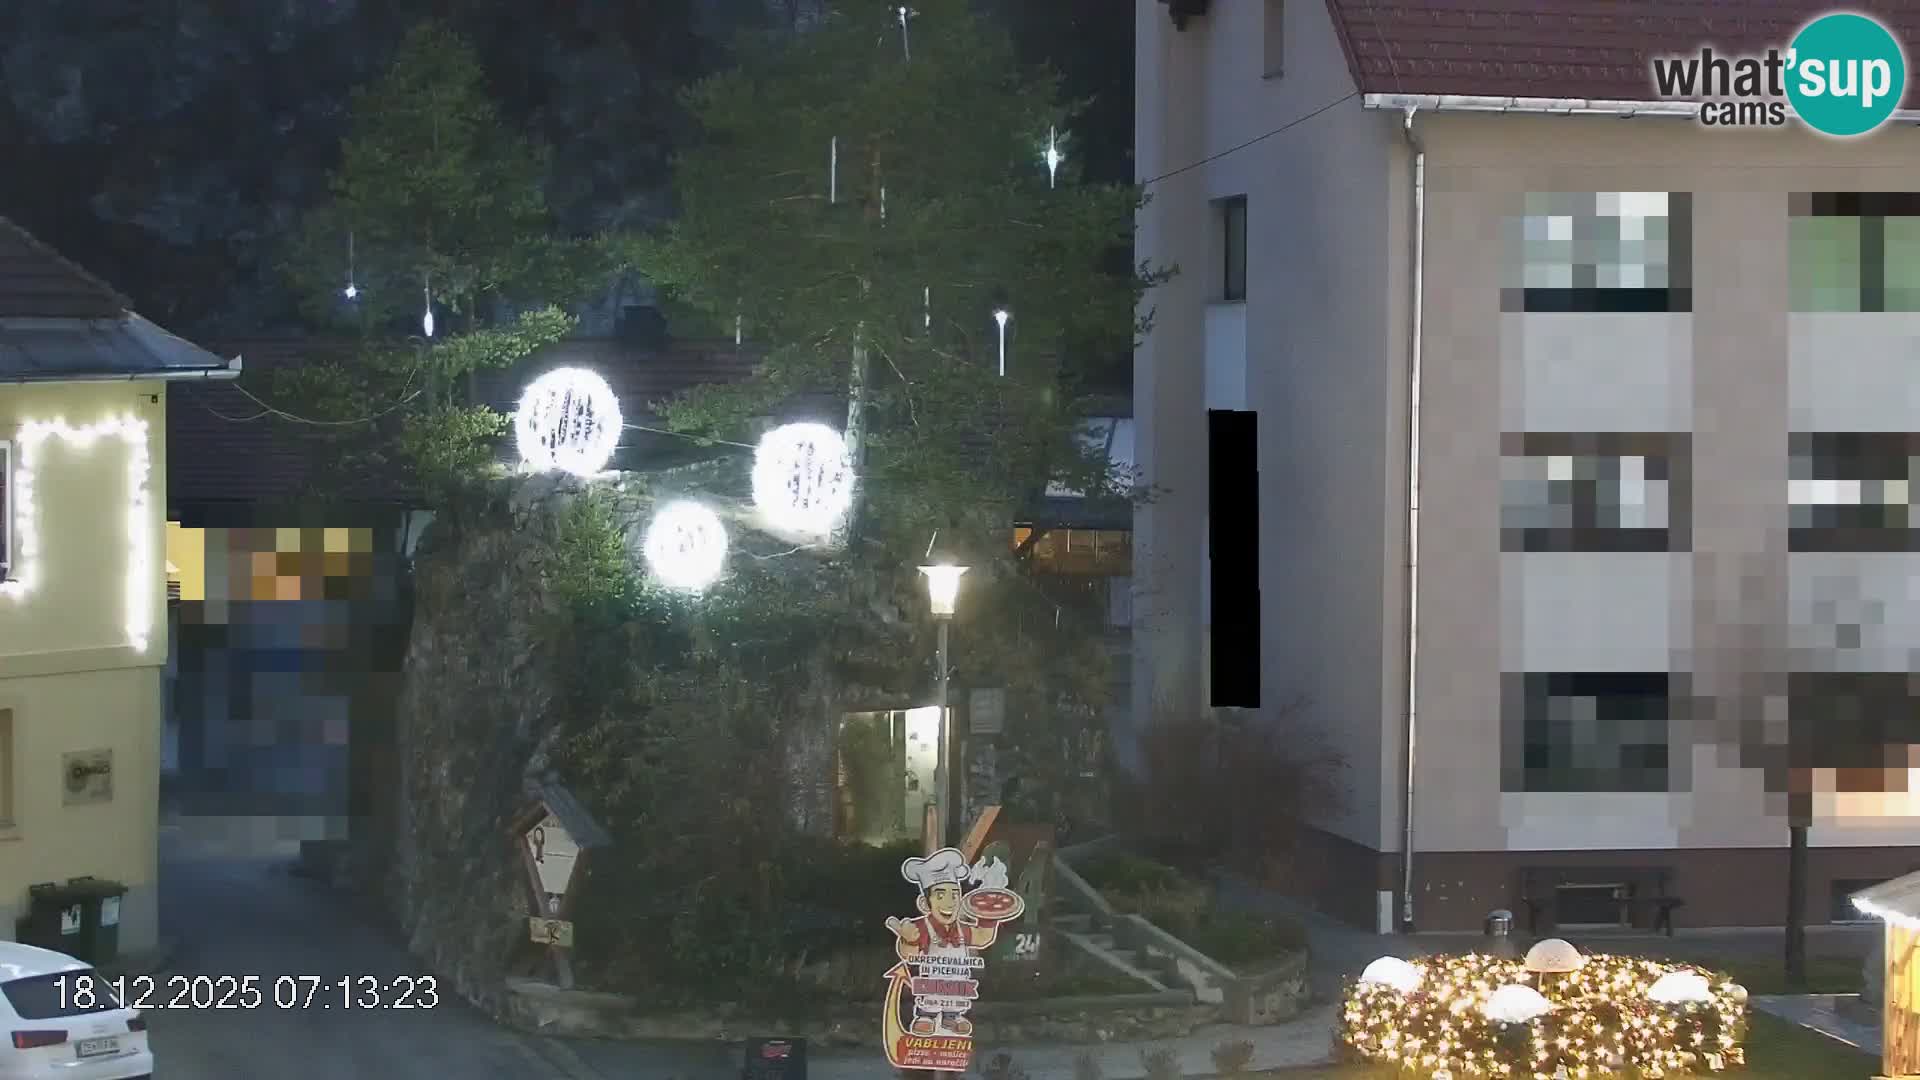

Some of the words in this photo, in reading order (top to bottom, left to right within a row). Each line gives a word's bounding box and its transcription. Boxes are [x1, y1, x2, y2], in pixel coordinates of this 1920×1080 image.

[921, 966, 930, 974] IN
[933, 966, 970, 976] PICERIJA
[905, 1038, 972, 1051] VABLJENI
